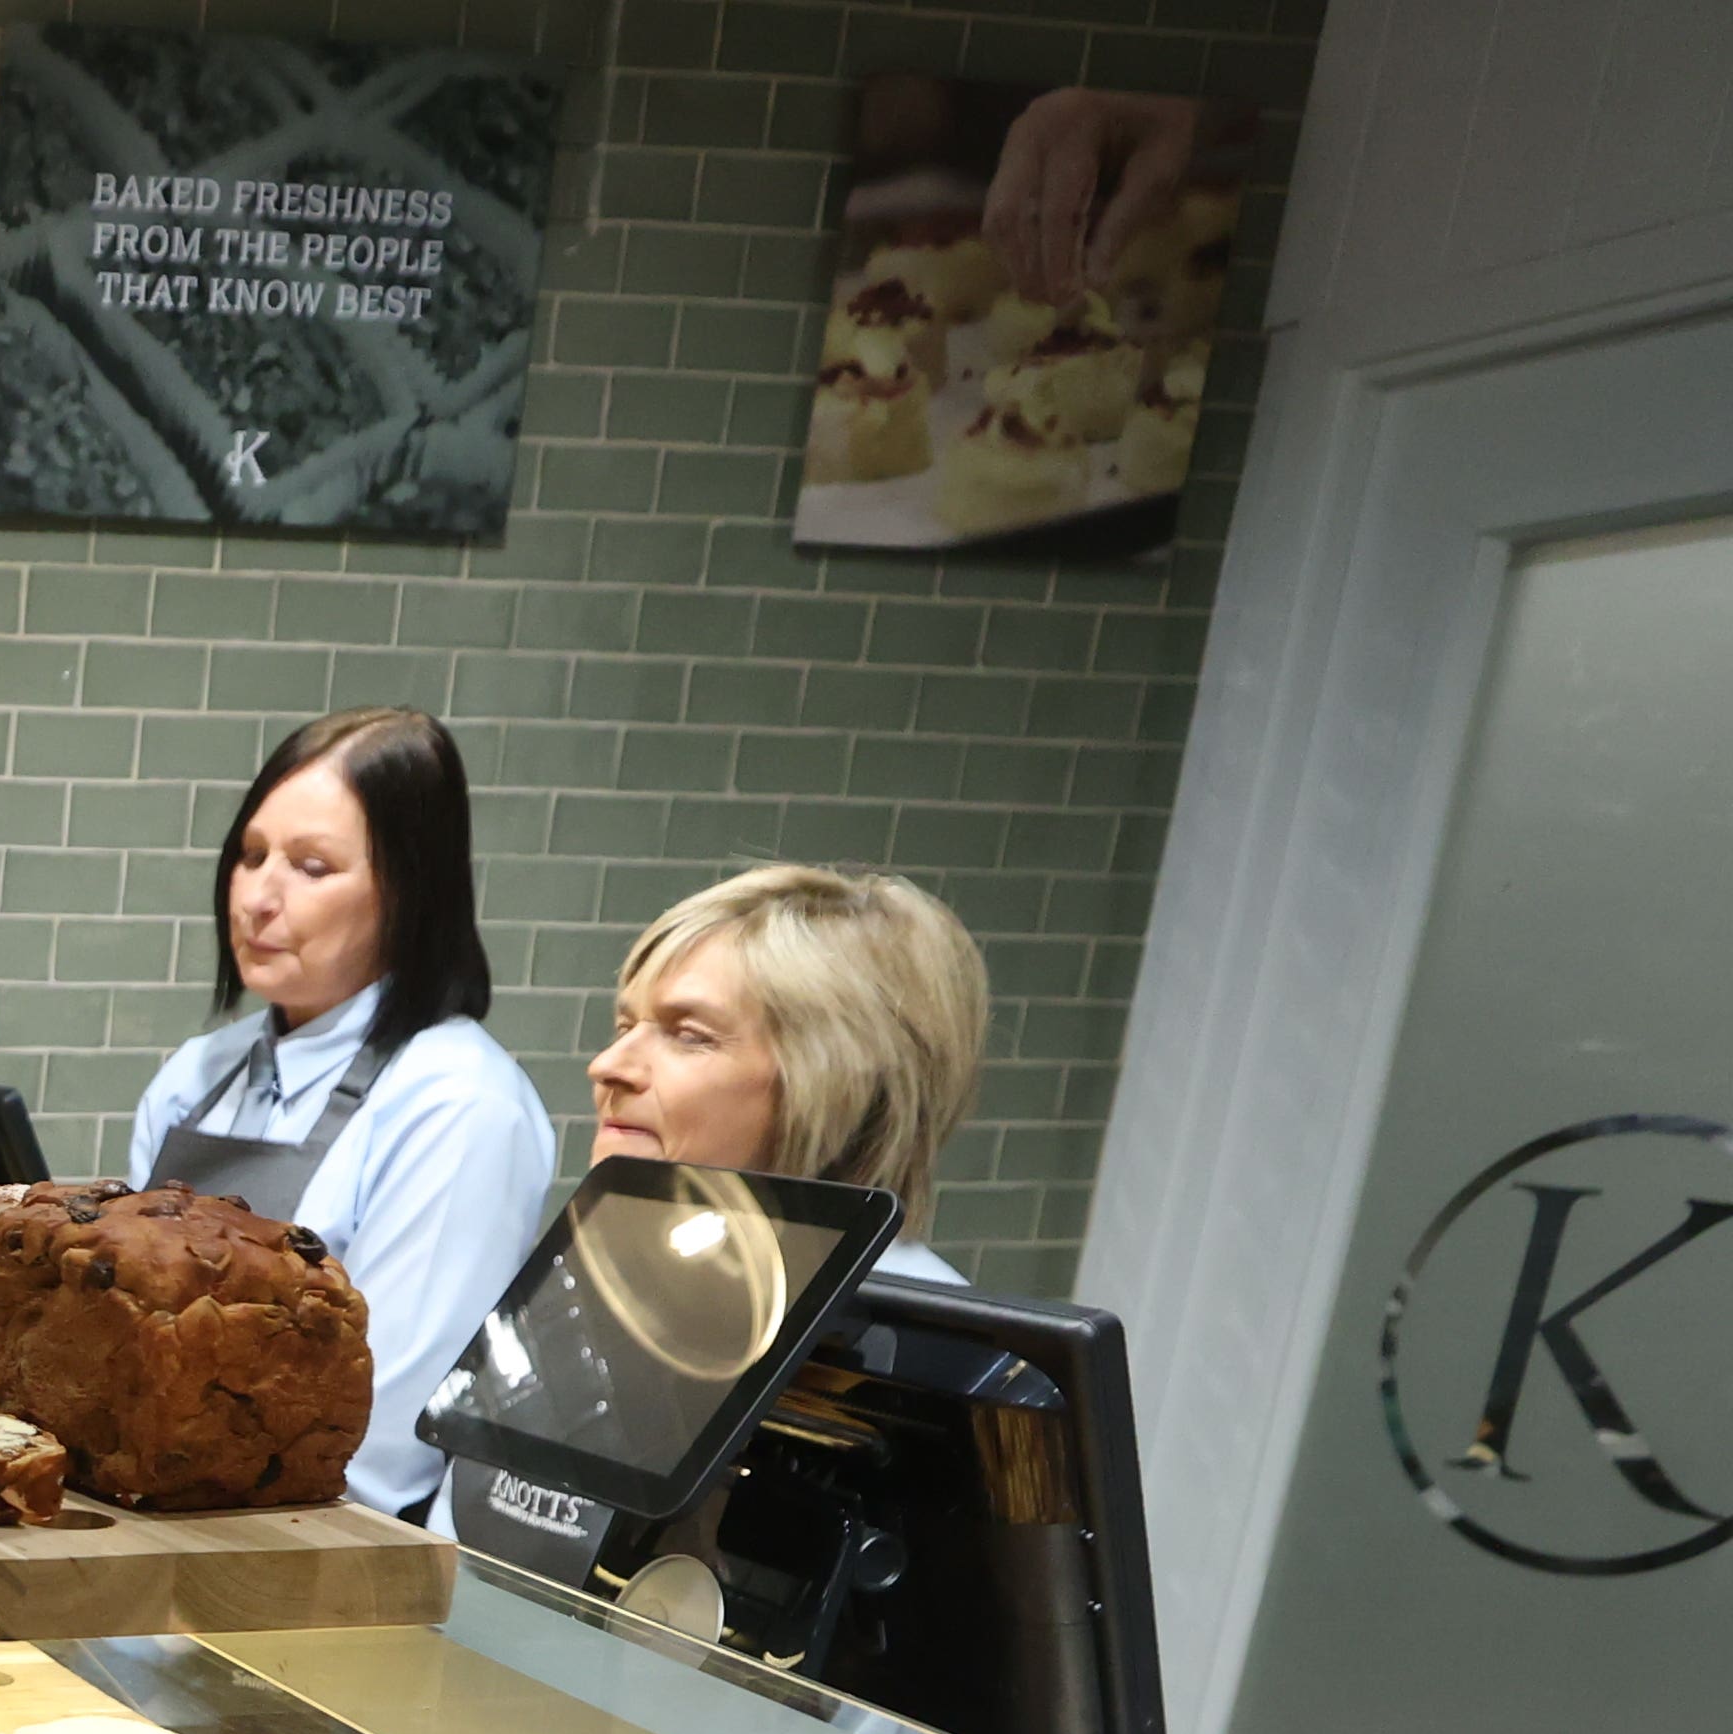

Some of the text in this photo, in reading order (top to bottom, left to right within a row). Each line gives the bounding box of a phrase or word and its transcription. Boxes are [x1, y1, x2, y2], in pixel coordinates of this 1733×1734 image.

[91, 172, 453, 227] BAKED FRESHNESS
[92, 222, 444, 274] FROM THE PEOPLE
[96, 271, 432, 320] THAT KNOW BEST
[224, 430, 271, 487] K
[1445, 1180, 1733, 1524] K
[492, 1468, 583, 1523] KNOTTS
